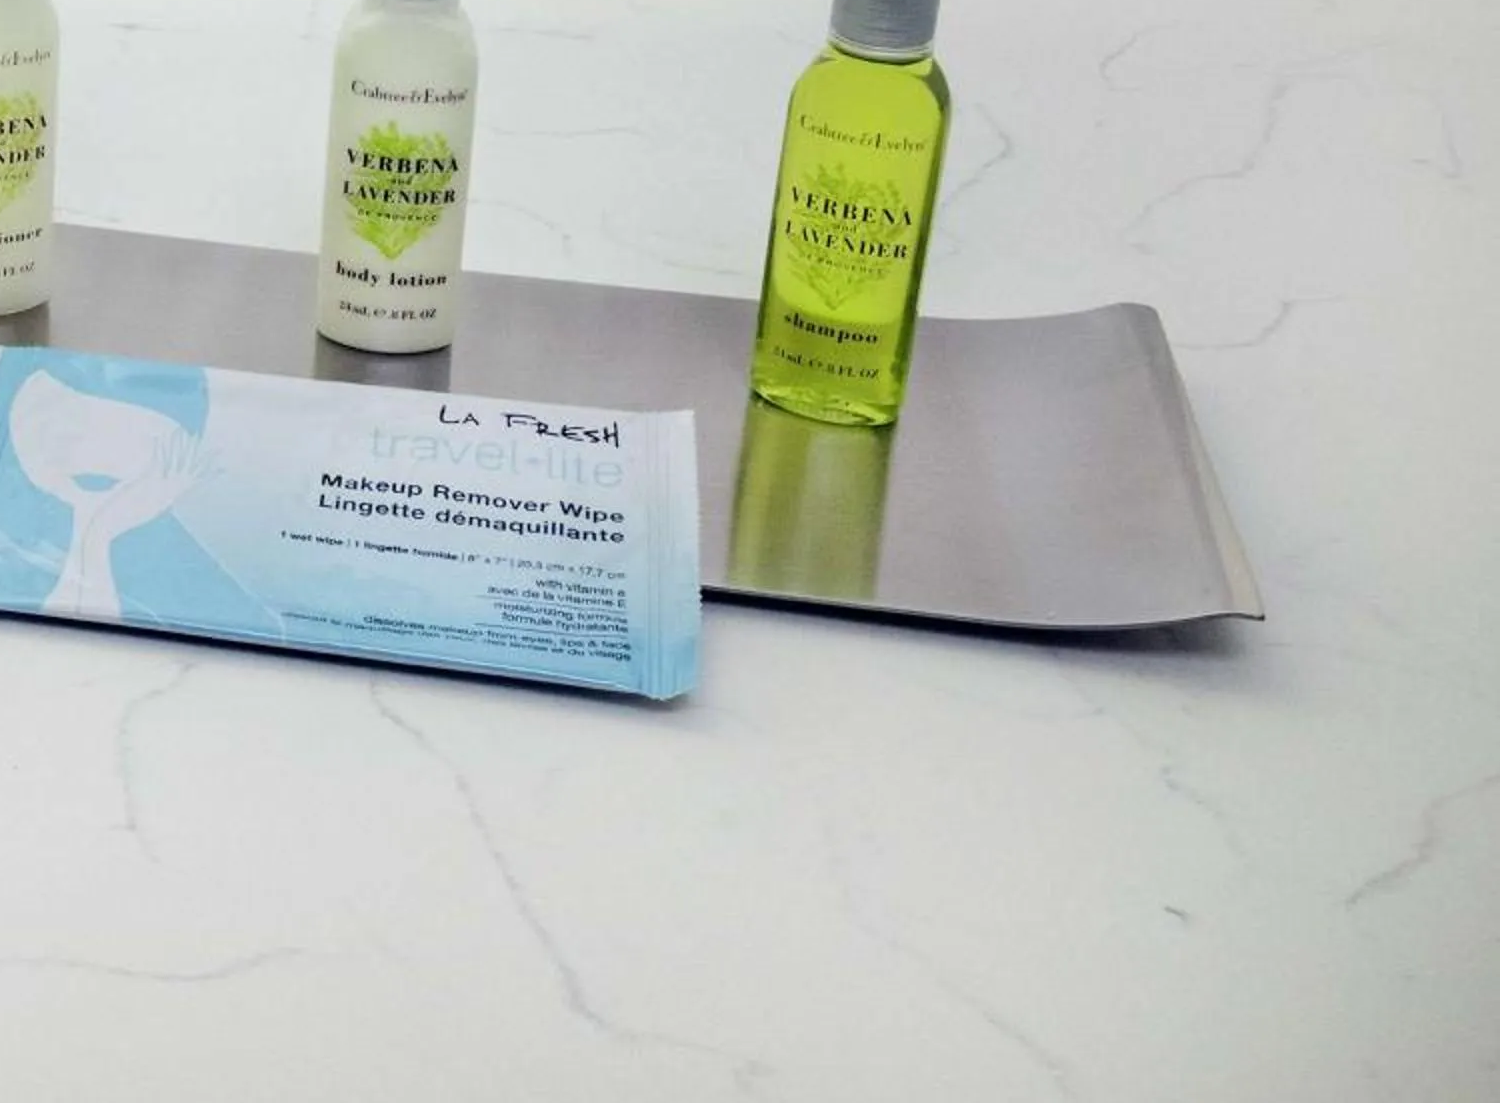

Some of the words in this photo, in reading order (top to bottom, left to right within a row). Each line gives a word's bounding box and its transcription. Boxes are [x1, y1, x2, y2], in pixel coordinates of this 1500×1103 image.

[346, 147, 459, 175] VERBENA
[343, 180, 456, 206] LAVENDER
[790, 185, 914, 227] VERBENA
[785, 220, 909, 259] LAVENDER
[335, 260, 380, 287] body
[389, 272, 448, 287] lotion
[784, 312, 879, 345] shampoo
[438, 404, 480, 426] LA
[501, 413, 620, 448] FRESH
[320, 472, 424, 498] Makeup
[433, 483, 551, 513] Remover
[558, 499, 625, 524] Wipe
[318, 493, 426, 521] Lingette
[435, 507, 625, 544] démaquillante
